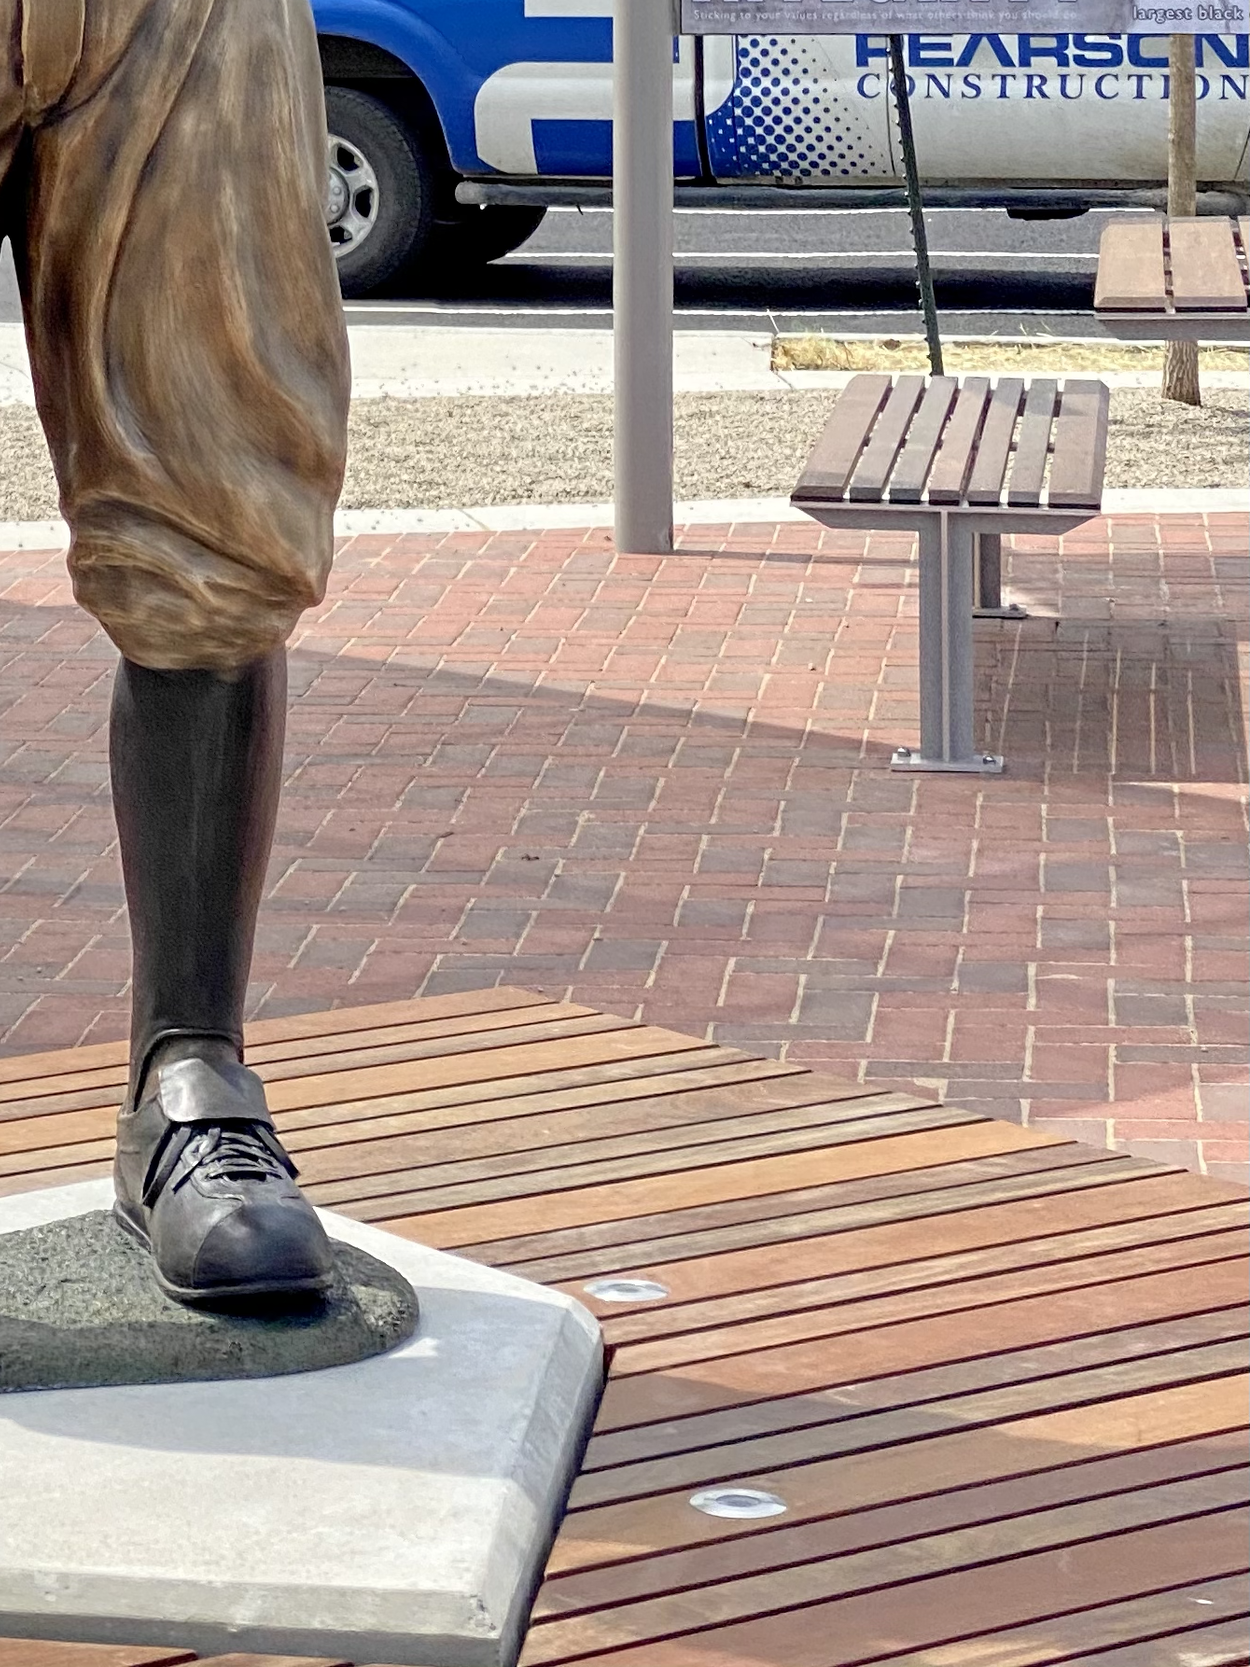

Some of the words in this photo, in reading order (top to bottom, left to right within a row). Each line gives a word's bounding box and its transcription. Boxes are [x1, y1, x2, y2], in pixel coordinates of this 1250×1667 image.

[693, 9, 736, 22] Sticking
[739, 10, 751, 20] to
[755, 11, 781, 22] your
[1132, 4, 1193, 25] largest
[1197, 4, 1245, 21] black
[856, 72, 1249, 101] CONSTRUCTION
